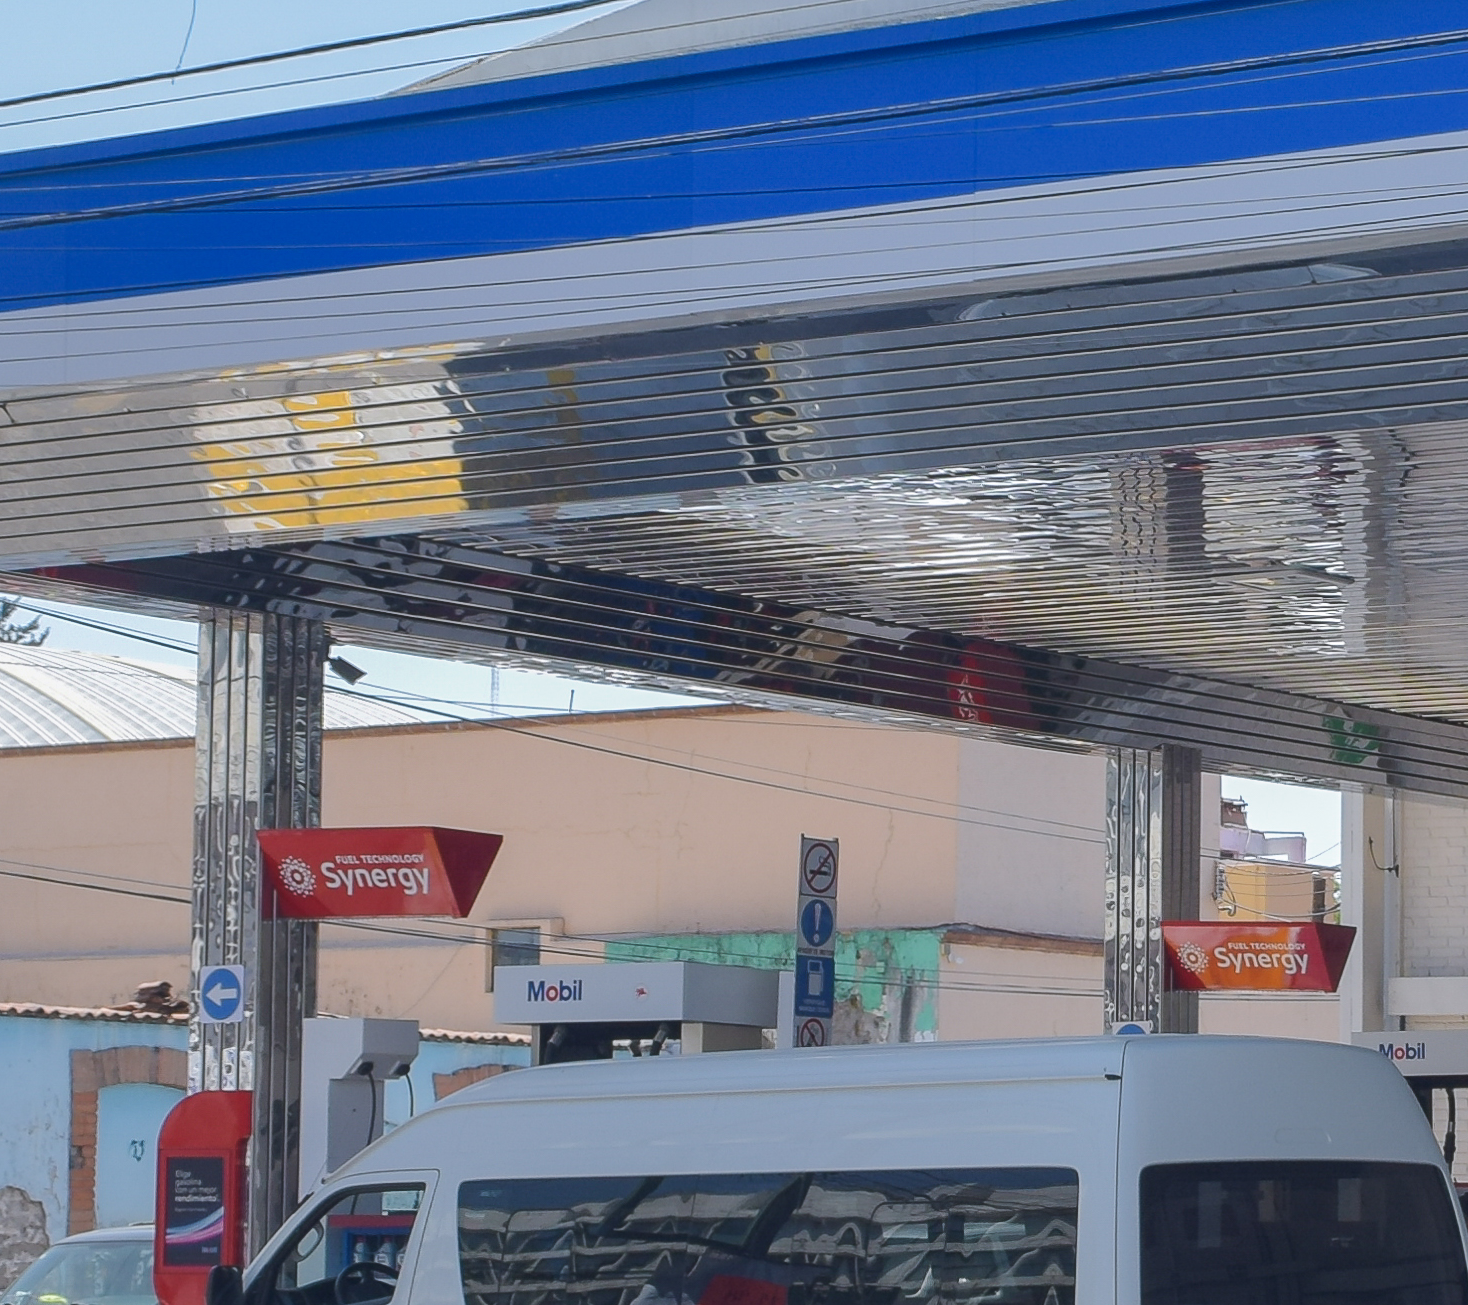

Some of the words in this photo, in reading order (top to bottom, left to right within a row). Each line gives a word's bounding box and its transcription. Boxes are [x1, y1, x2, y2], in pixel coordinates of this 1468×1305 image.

[335, 855, 359, 864] FUEL
[361, 854, 424, 864] TECHNOLOGY
[320, 862, 429, 896] Synergy
[1227, 942, 1248, 950] FUEL
[1250, 942, 1305, 950] TECHNOLOGY
[1213, 947, 1309, 975] Synergy
[527, 980, 583, 1002] Mobil
[1378, 1042, 1426, 1060] Mobil
